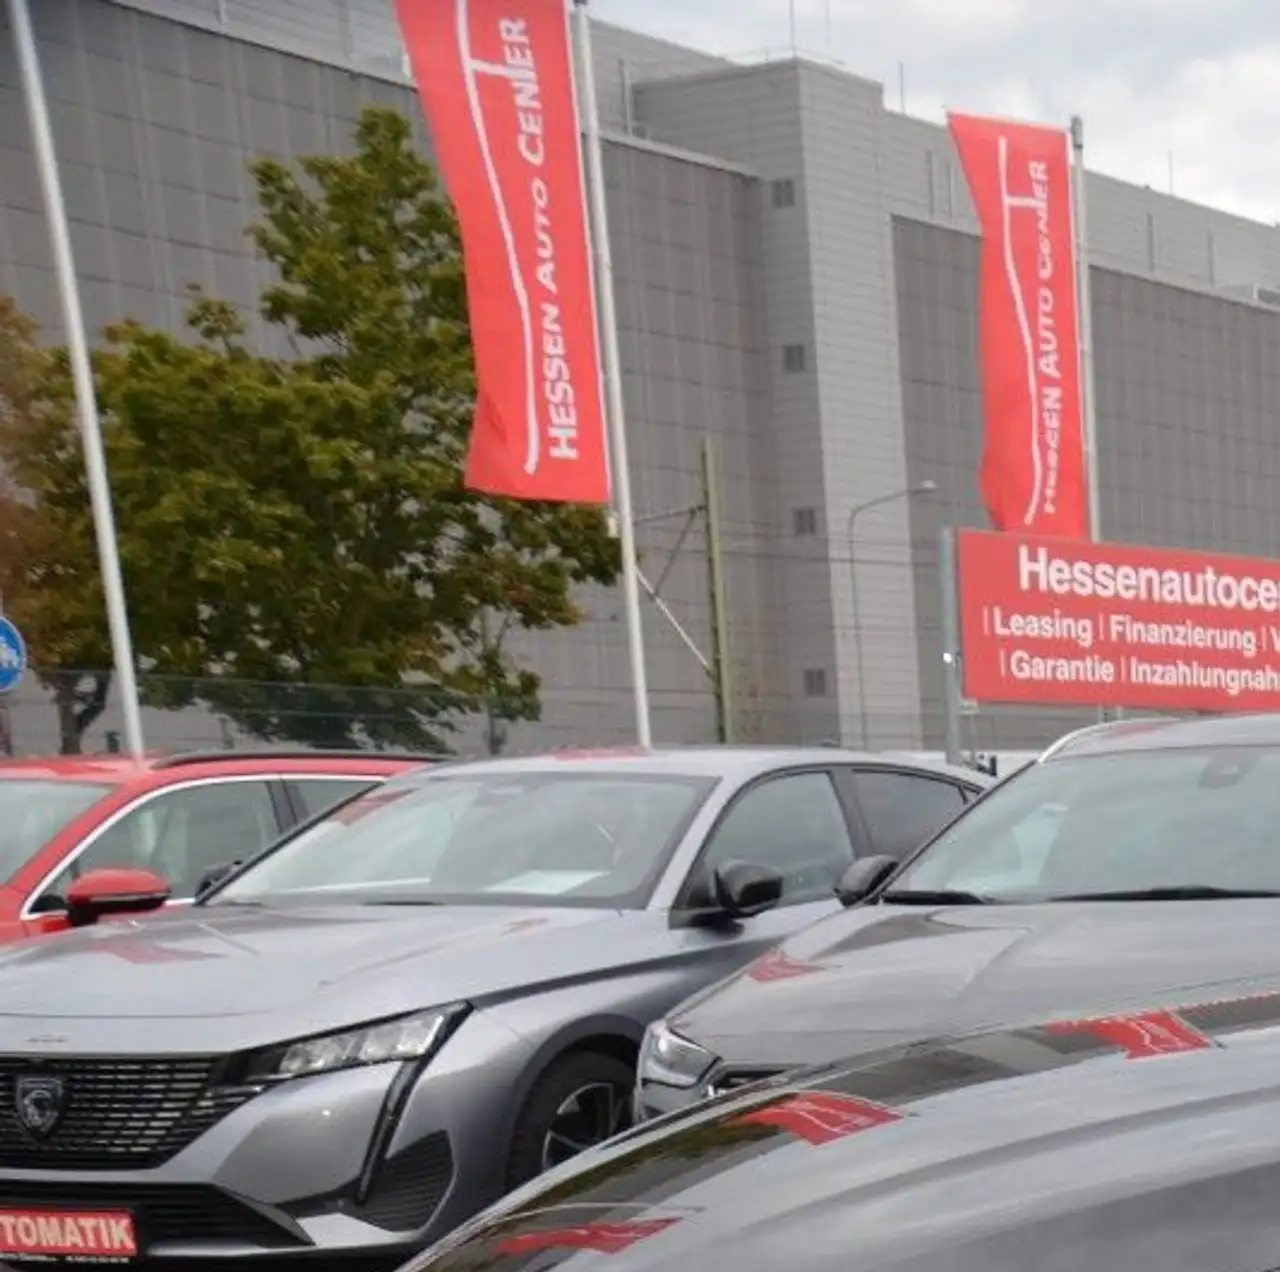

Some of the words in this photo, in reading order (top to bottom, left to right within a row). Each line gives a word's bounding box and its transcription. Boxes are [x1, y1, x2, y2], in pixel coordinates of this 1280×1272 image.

[532, 177, 557, 294] AUTO
[1038, 287, 1062, 378] AUTO
[547, 303, 579, 460] HESSEN
[993, 606, 1093, 648] Leasing
[1110, 613, 1257, 659] Finanzierung
[1010, 650, 1114, 683] Garantie
[0, 1215, 136, 1250] TOMATIK
